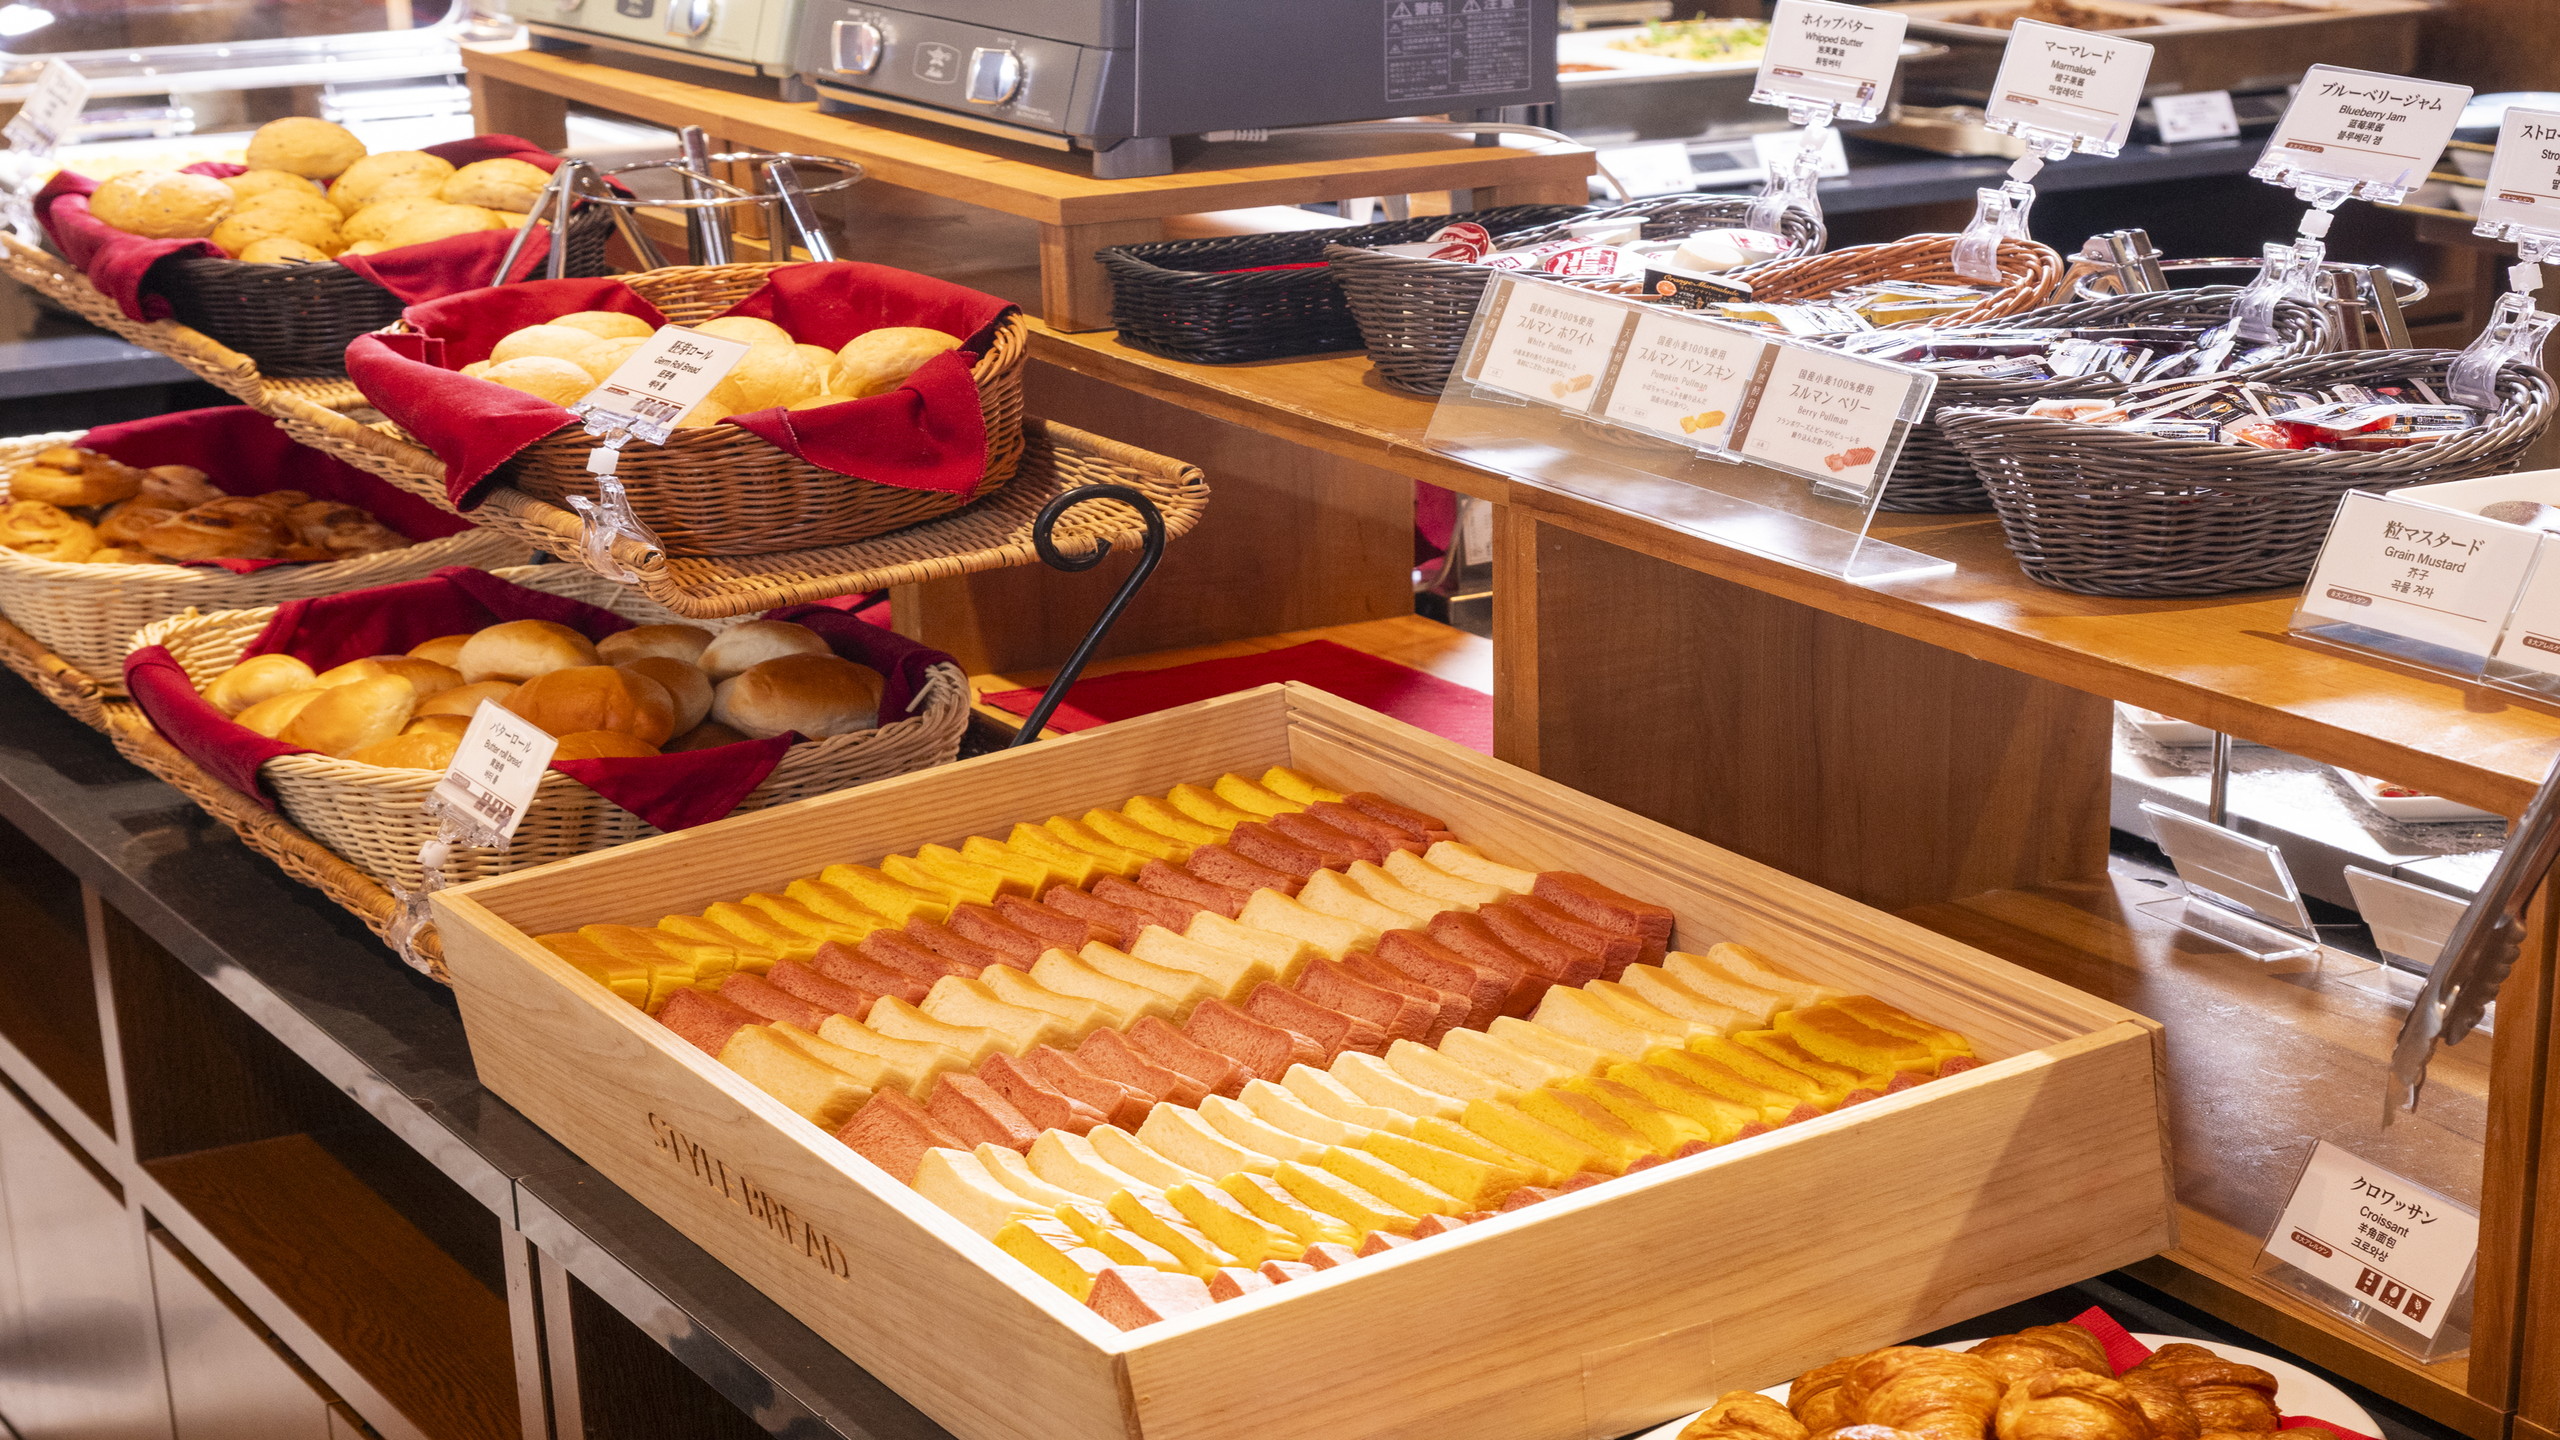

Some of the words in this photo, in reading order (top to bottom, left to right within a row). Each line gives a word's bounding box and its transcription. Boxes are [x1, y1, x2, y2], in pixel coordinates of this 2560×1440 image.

[1802, 13, 1874, 32] ホイップバター
[1806, 32, 1839, 44] Whipped
[1840, 36, 1864, 47] Butter
[2045, 41, 2115, 64] マーマレード
[2050, 60, 2097, 77] Marmalade
[2319, 82, 2442, 111] ブルーベリージャム
[2338, 105, 2386, 122] Blueberry
[2384, 111, 2406, 123] Jam
[2337, 130, 2372, 144] 블루베리
[2520, 124, 2560, 140] ストロ
[2541, 149, 2560, 161] Stro
[1663, 274, 1694, 287] Orange
[1530, 303, 1595, 328] 国産小麦100%使用
[1475, 295, 1506, 362] 天然酵母パン
[1516, 315, 1556, 336] プルマン
[1557, 326, 1595, 347] ホワイト
[668, 340, 714, 360] 胚芽ロール
[1527, 336, 1546, 348] White
[1657, 335, 1727, 360] 国産小麦100%使用
[681, 363, 703, 374] Bread
[1601, 328, 1631, 398] 天然酵母パン
[1638, 347, 1679, 367] プルマン
[1681, 358, 1735, 381] パンプキン
[1651, 369, 1678, 384] Pumpkin
[1681, 376, 1708, 391] Pullman
[1798, 368, 1875, 396] 国産小麦100%使用
[1737, 361, 1770, 433] 天然酵母パン
[1789, 384, 1834, 405] プルマン
[1838, 396, 1870, 412] ベリー
[1797, 405, 1818, 420] Berry
[1819, 411, 1848, 426] Pullman
[2383, 520, 2485, 556] 粒マスタード
[2384, 546, 2415, 562] Grain
[2417, 553, 2466, 573] Mustard
[2413, 584, 2434, 599] 겨자
[2528, 638, 2560, 653] 8大アレルゲ
[489, 722, 531, 753] バターロール
[484, 739, 500, 754] Butter
[506, 753, 523, 768] bread
[648, 1112, 740, 1207] STYLE
[740, 1176, 850, 1283] BREAD
[2350, 1176, 2438, 1225] クロワッサン
[2360, 1206, 2410, 1238] Croissant
[2358, 1222, 2397, 1249] 羊角面包
[2351, 1237, 2389, 1263] 크로와상
